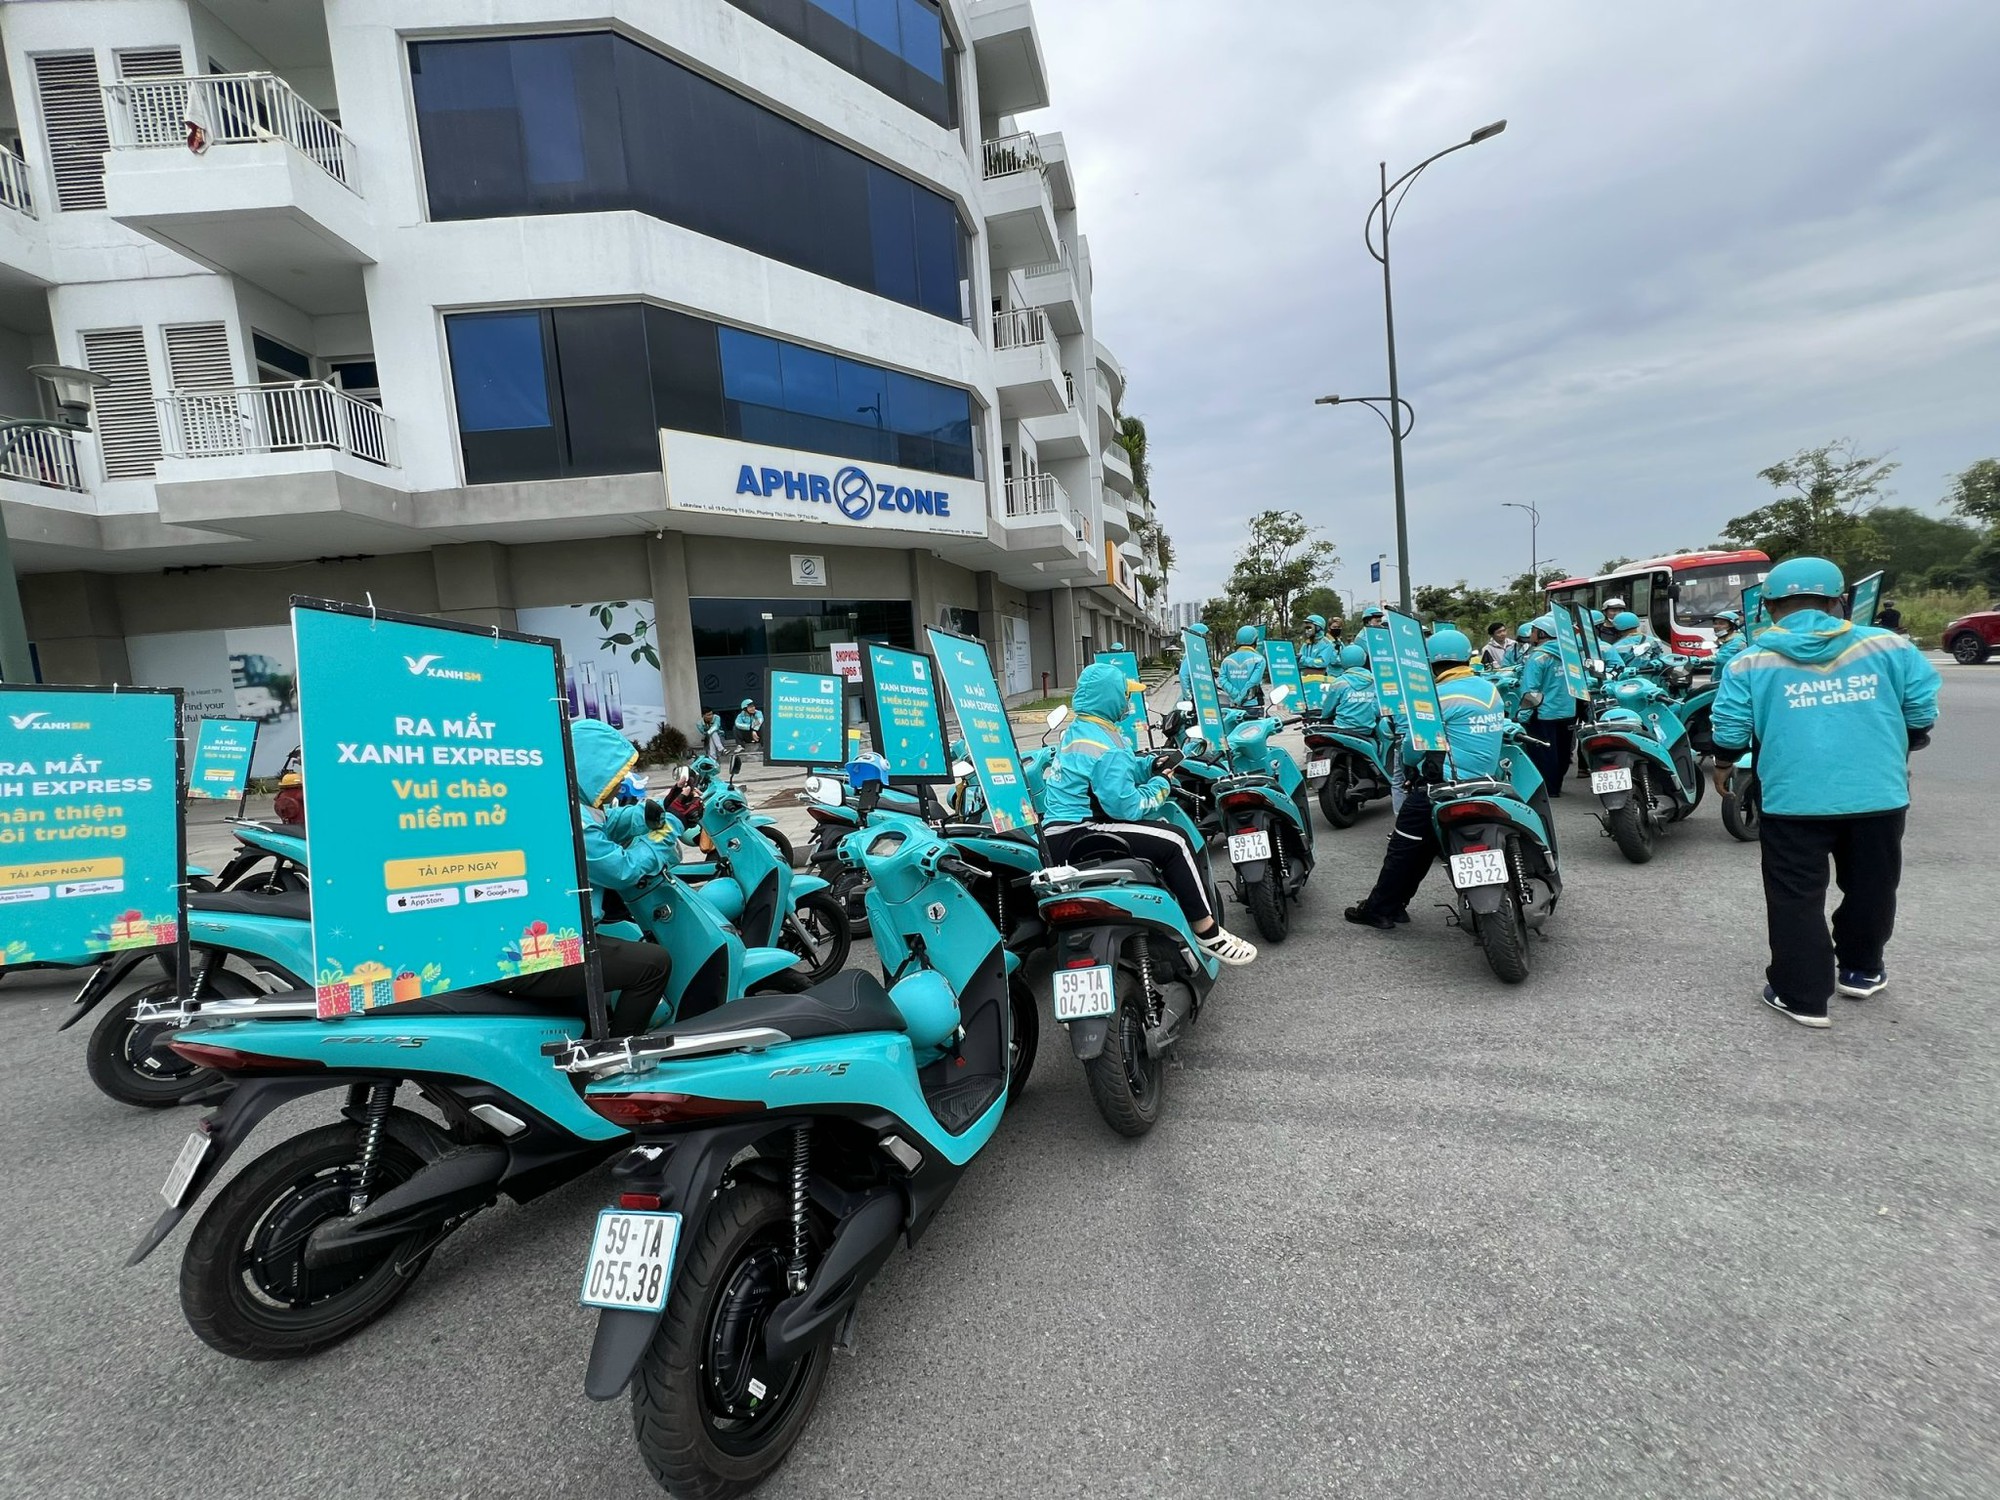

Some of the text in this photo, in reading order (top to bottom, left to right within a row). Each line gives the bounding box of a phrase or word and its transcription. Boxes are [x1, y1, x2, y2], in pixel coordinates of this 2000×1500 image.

[879, 682, 929, 696] XANH EXPRESS
[1784, 674, 1878, 697] XANH SM
[801, 697, 834, 706] EXPRESS
[958, 697, 1000, 713] XANH EXPRESS
[1789, 687, 1876, 709] xin chào!
[204, 702, 225, 712] your
[395, 712, 496, 739] RA MẮT
[1468, 712, 1496, 724] XANH
[1470, 724, 1487, 735] xin
[337, 743, 544, 766] XANH EXPRESS
[45, 753, 103, 774] MẮT
[1598, 771, 1624, 782] 59-T2
[33, 778, 153, 796] EXPRESS
[392, 778, 508, 799] Vui chào
[1596, 780, 1628, 792] 666.21
[54, 805, 123, 821] thiện
[399, 804, 507, 829] niềm nở
[34, 824, 127, 842] trường
[1234, 834, 1262, 848] 59-T2
[1234, 846, 1267, 861] 674.40
[1459, 853, 1496, 870] 59-T2
[33, 869, 57, 878] APP
[61, 865, 95, 875] NGAY
[418, 861, 499, 877] TẢI APP NGAY
[1458, 867, 1503, 885] 679.22
[486, 889, 507, 898] Google
[508, 887, 520, 896] Play
[411, 896, 445, 907] App Store
[1062, 970, 1103, 994] 59-TA
[1060, 991, 1109, 1016] 047.30
[605, 1217, 664, 1258] 59-TA
[589, 1260, 662, 1303] 055.38
